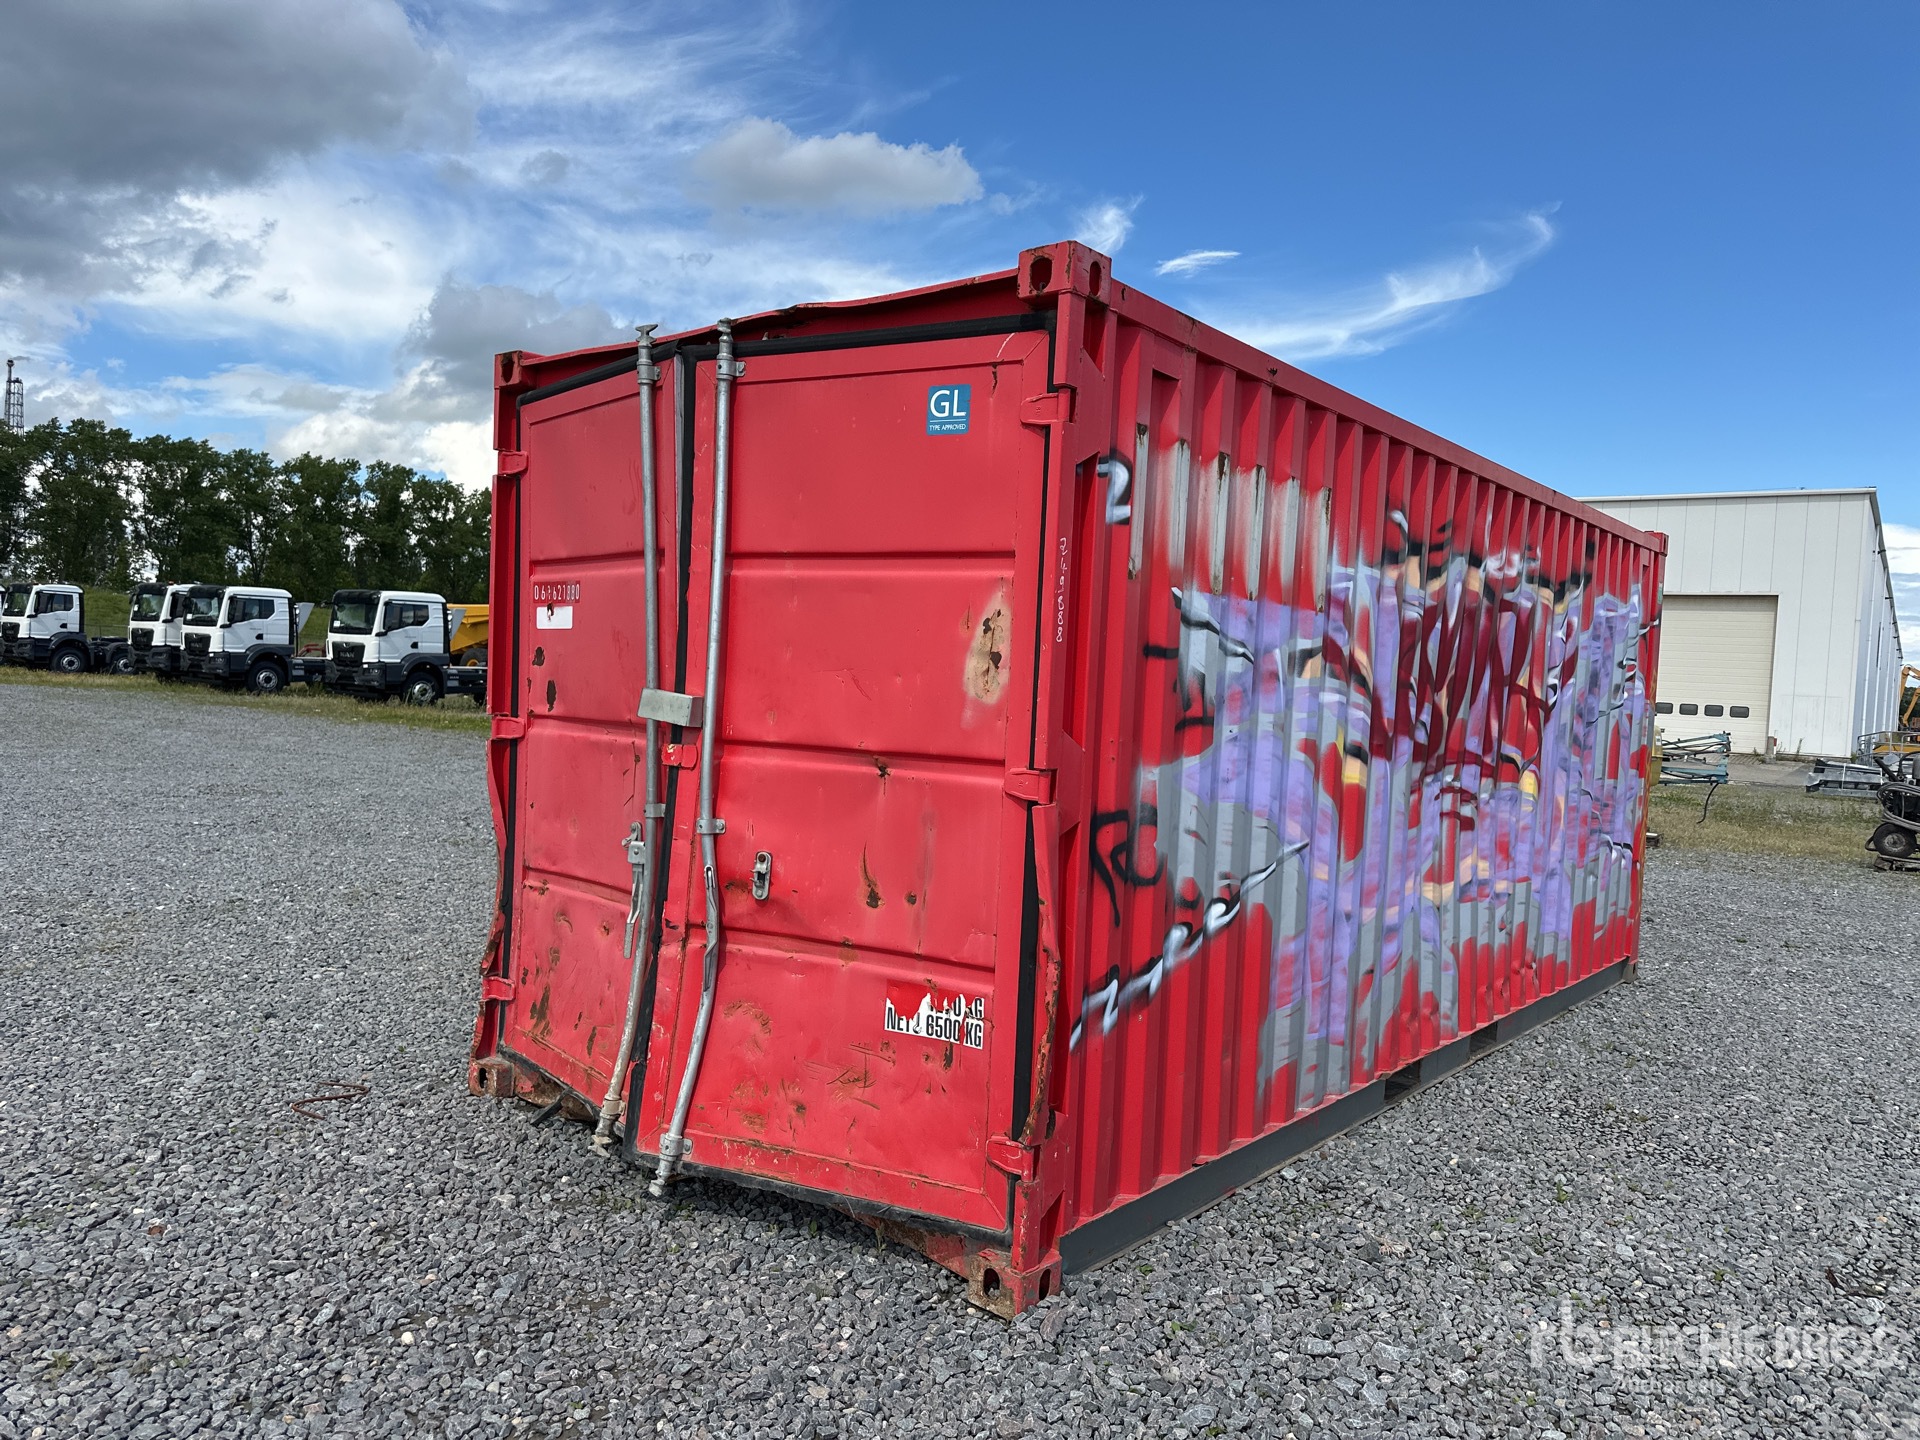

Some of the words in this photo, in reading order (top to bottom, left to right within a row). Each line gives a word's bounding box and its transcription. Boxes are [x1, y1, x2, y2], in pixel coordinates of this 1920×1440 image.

[930, 389, 967, 418] GL
[929, 424, 941, 432] TYPE
[941, 423, 967, 431] APPROVED
[926, 1014, 961, 1042] 6500
[965, 1021, 982, 1048] KG
